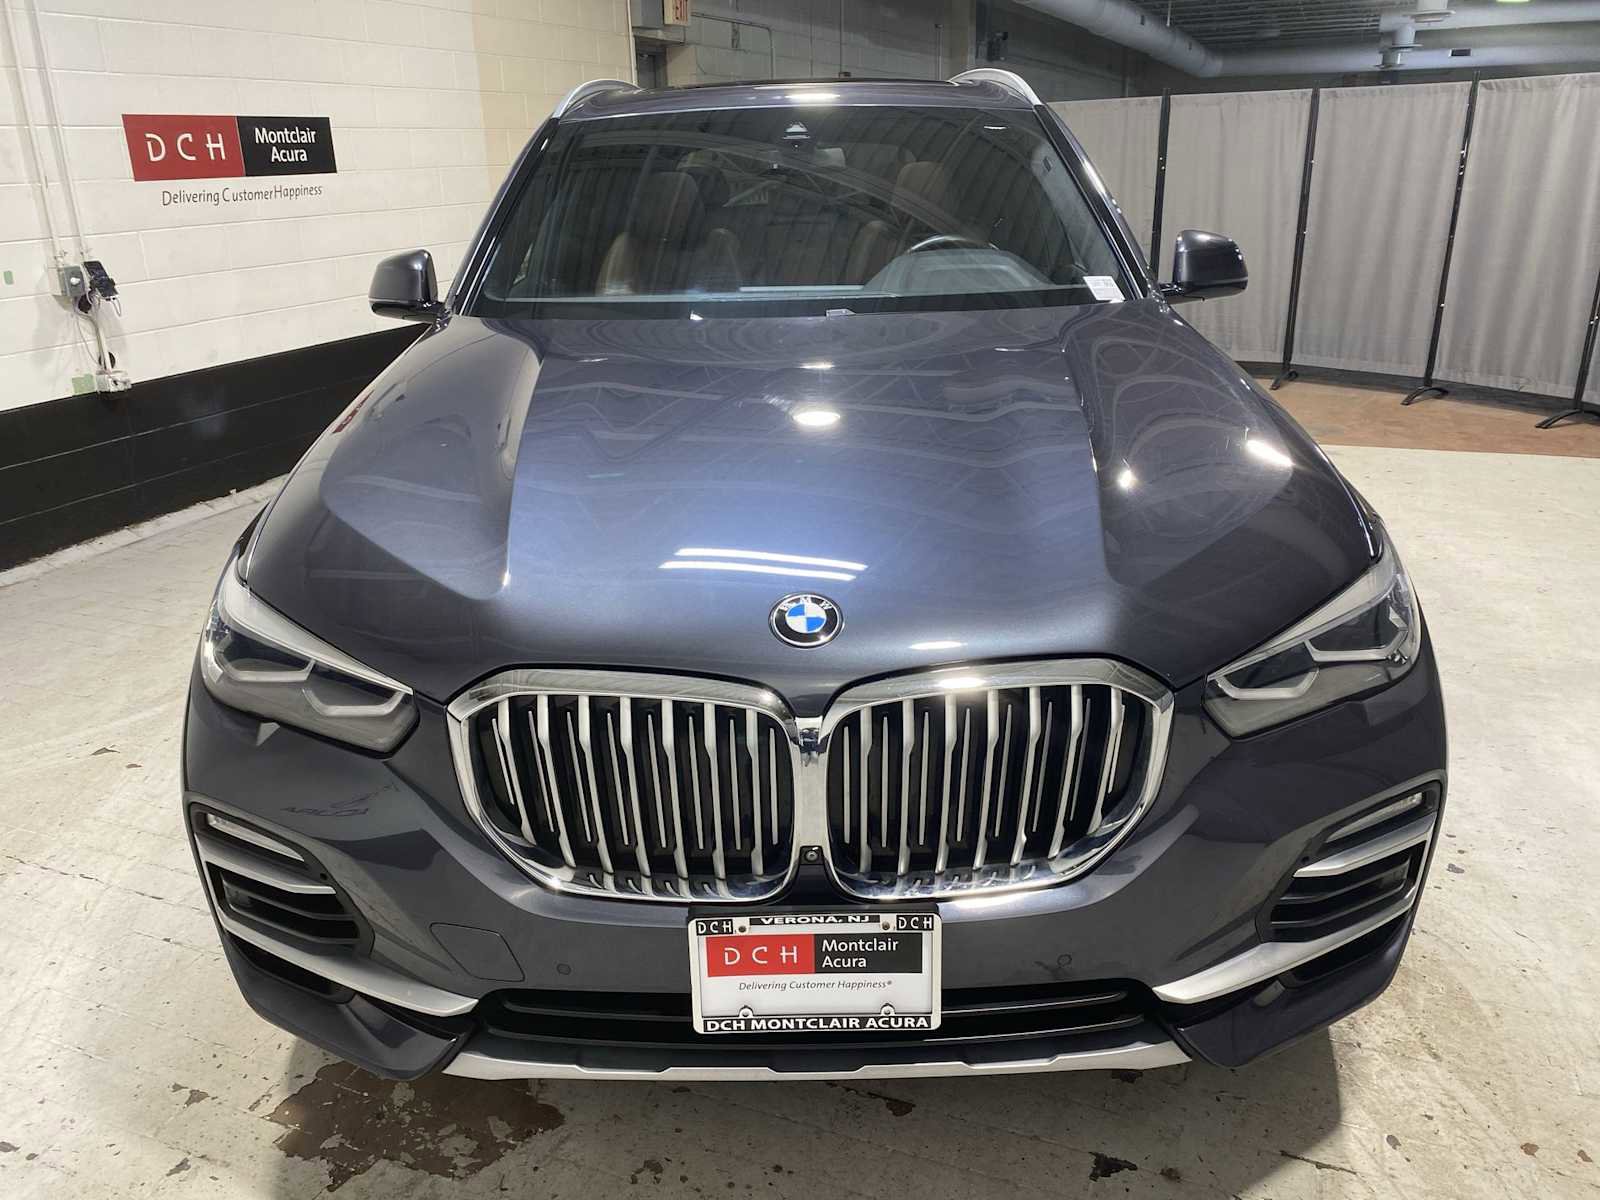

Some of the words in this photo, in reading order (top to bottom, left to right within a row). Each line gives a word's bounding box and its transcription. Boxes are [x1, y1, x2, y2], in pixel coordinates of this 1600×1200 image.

[254, 127, 316, 144] Montclair
[271, 146, 308, 162] Acura
[162, 190, 219, 206] Delivering
[274, 185, 322, 199] Happiness
[848, 915, 870, 923] NJ
[898, 917, 933, 930] DCH
[698, 921, 732, 934] DCH
[821, 938, 899, 952] Montclair
[821, 956, 867, 968] Acura
[738, 982, 787, 991] Delivering
[789, 981, 835, 989] Customer
[706, 1020, 746, 1031] DCH
[750, 1019, 860, 1030] MONTCLAIR
[866, 1017, 929, 1028] ACURA
